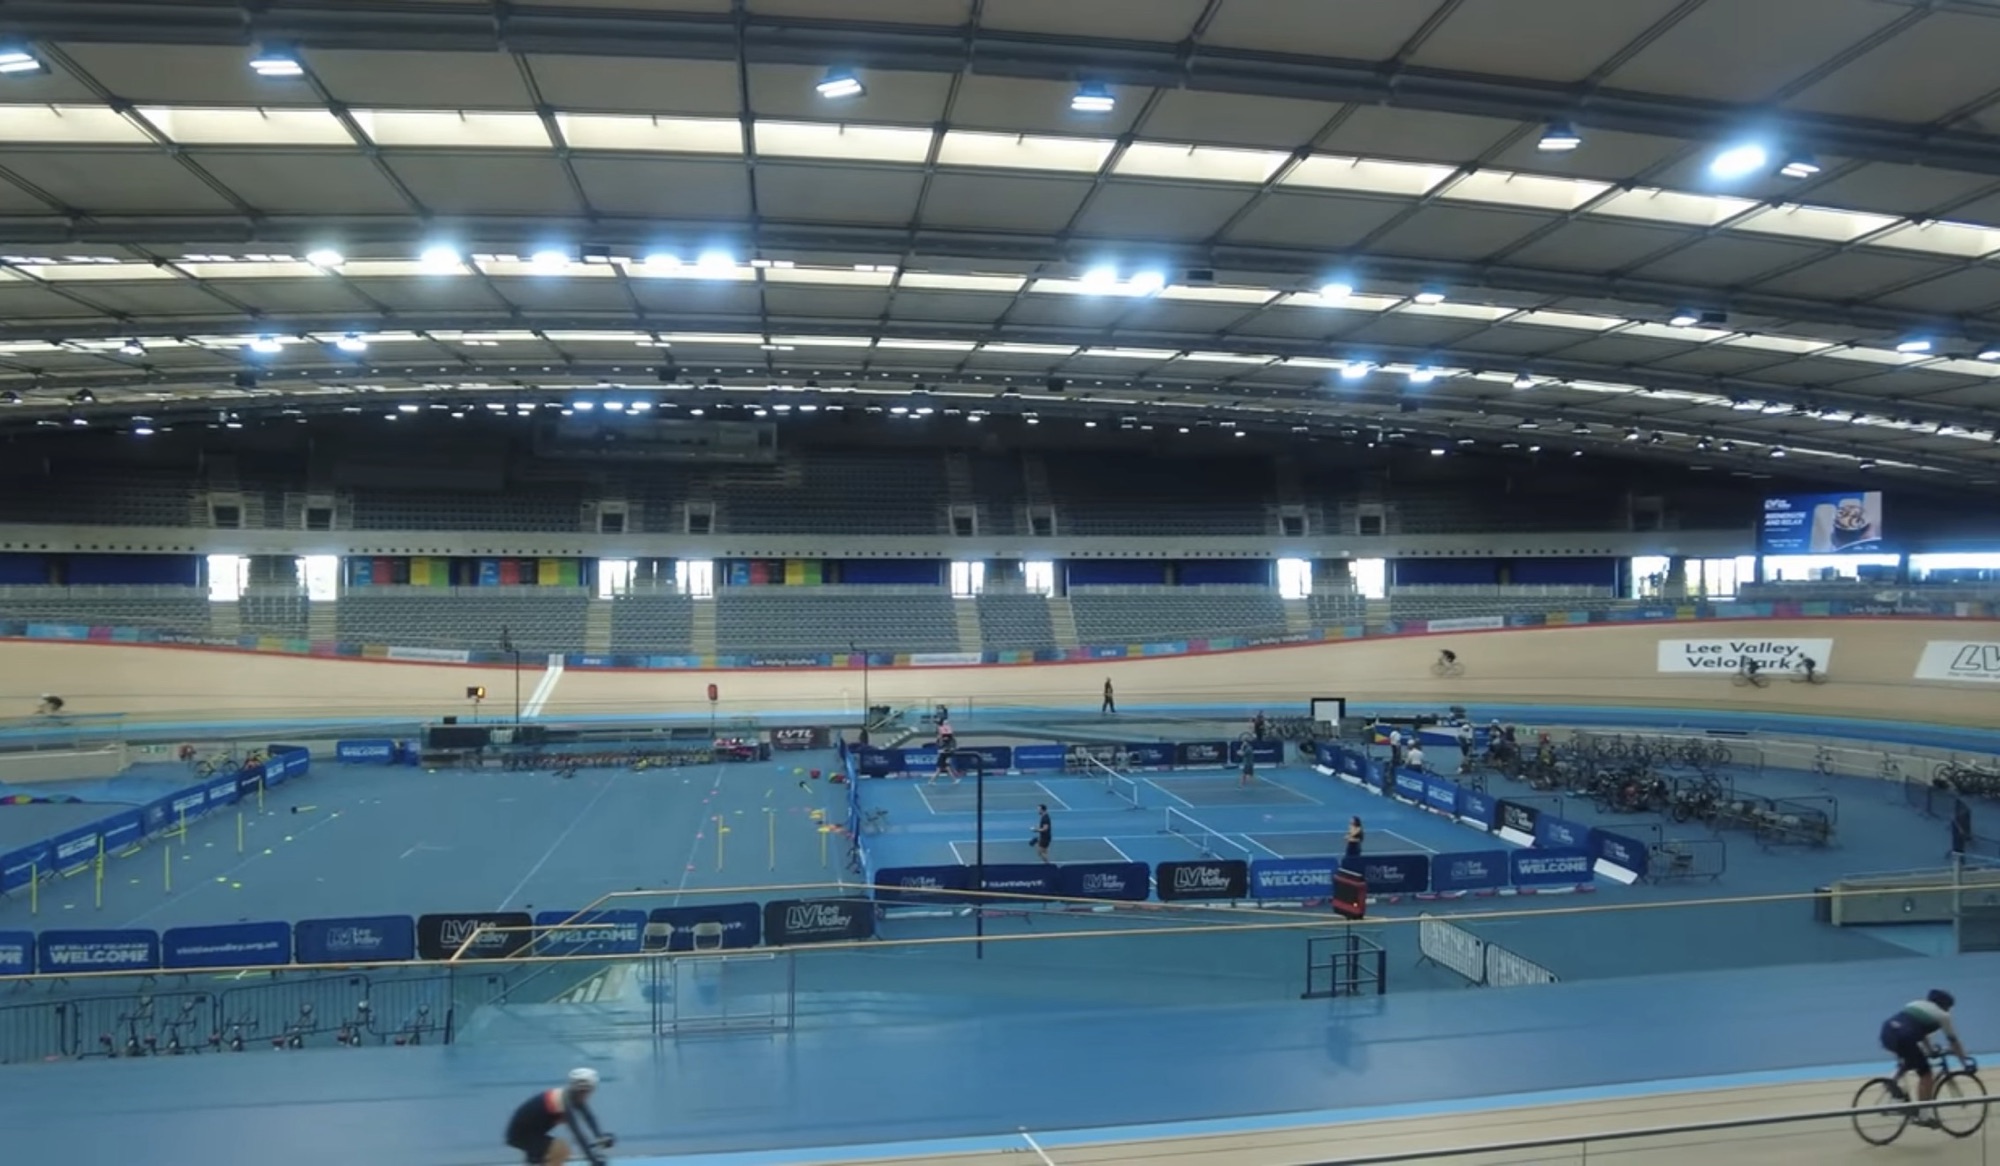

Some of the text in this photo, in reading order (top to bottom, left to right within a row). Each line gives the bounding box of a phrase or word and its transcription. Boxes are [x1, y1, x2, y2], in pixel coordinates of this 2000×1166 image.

[1685, 642, 1799, 657] Lee Valley
[1200, 867, 1220, 876] Lee
[1519, 861, 1588, 874] WELCOME
[1174, 867, 1201, 888] LV
[1200, 875, 1231, 888] Valley
[1260, 873, 1332, 888] WELCOME
[785, 905, 818, 929] LV
[817, 904, 839, 916] Lee
[472, 919, 497, 930] Lee
[817, 914, 852, 927] Valley
[352, 927, 371, 936] Lee
[440, 919, 473, 944] LV
[548, 928, 638, 943] WELCOME
[50, 949, 149, 964] WELCOME
